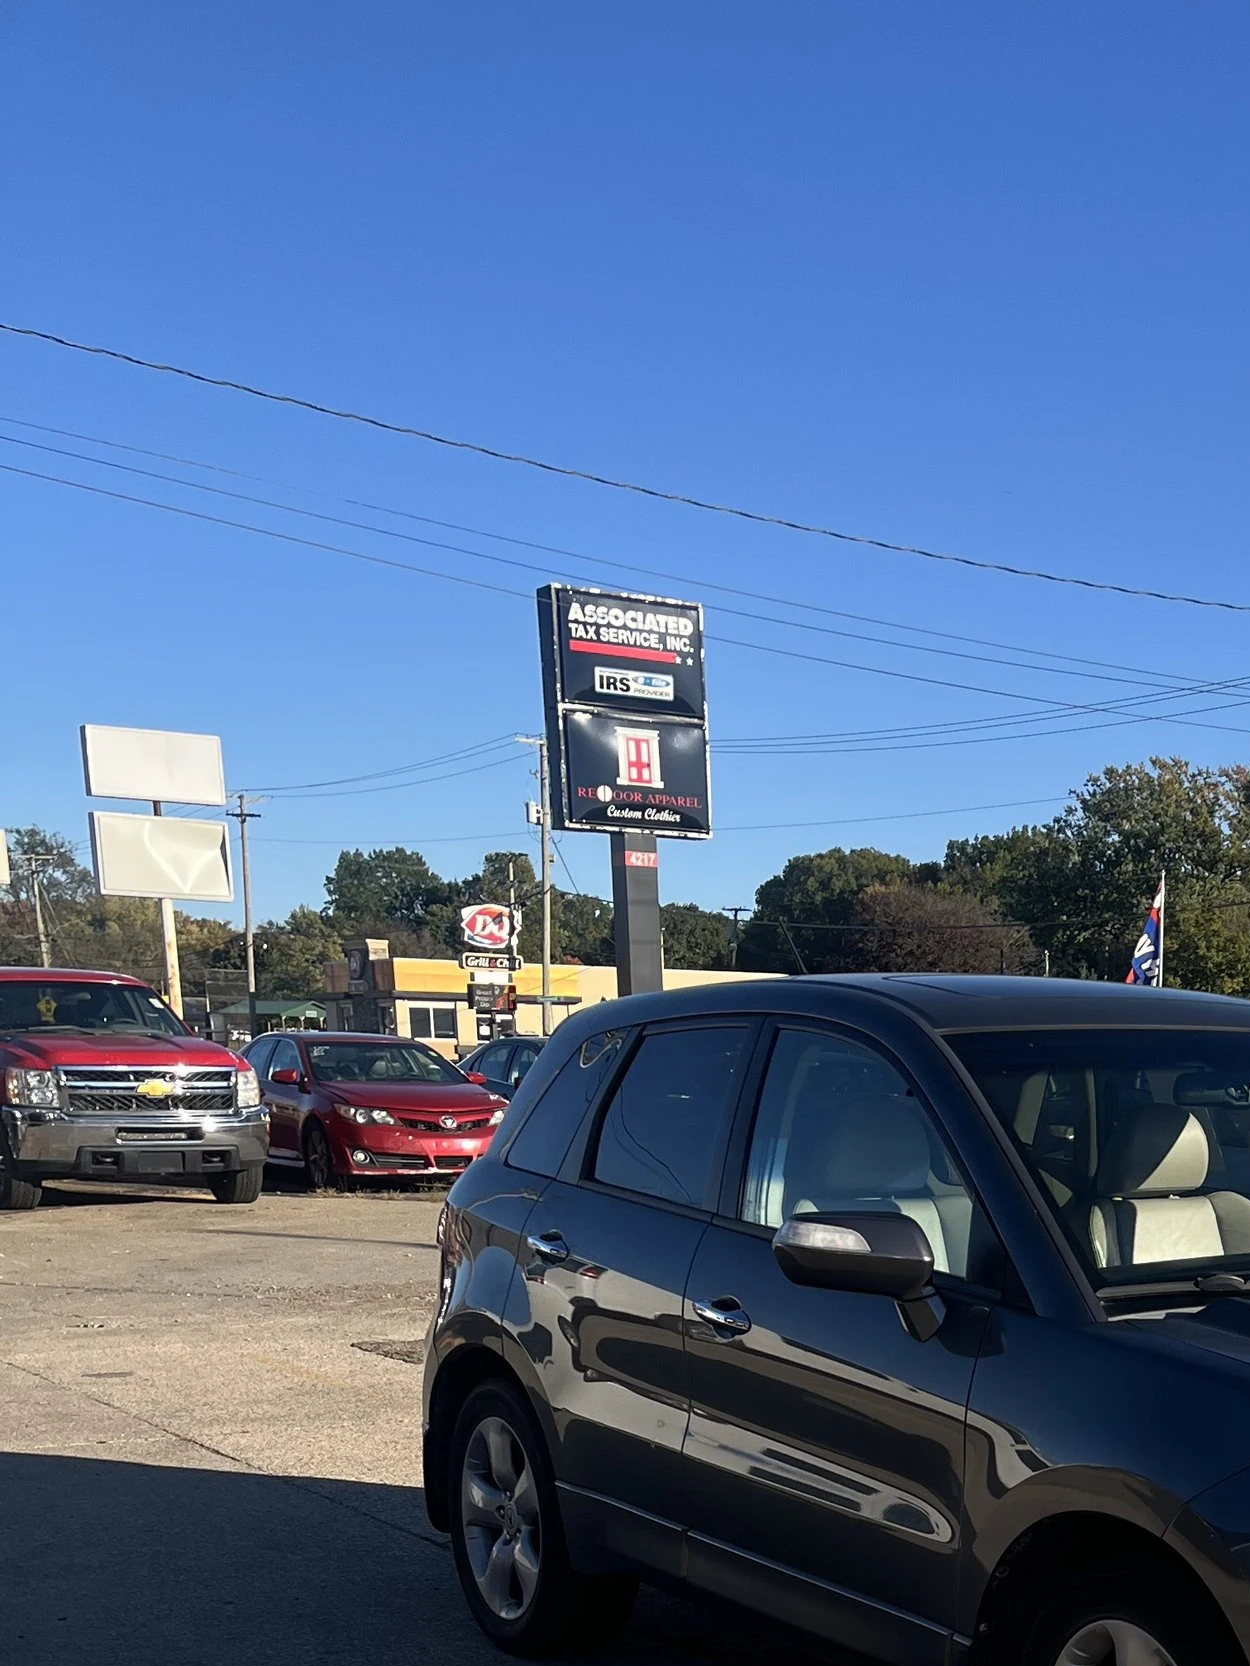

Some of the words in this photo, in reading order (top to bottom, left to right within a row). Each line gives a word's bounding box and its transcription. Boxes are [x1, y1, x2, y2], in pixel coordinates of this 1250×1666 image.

[567, 602, 694, 636] ASSOCIATED
[568, 623, 597, 640] TAX
[599, 627, 663, 651] SERVICE,
[666, 635, 694, 653] INC.
[599, 674, 631, 693] IRS
[633, 687, 670, 698] PROVIDER
[646, 794, 702, 809] APPAREL
[607, 804, 643, 820] Custom
[644, 808, 681, 823] Clothier
[630, 852, 656, 866] 4217
[474, 914, 510, 938] DQ
[467, 957, 489, 968] Grill
